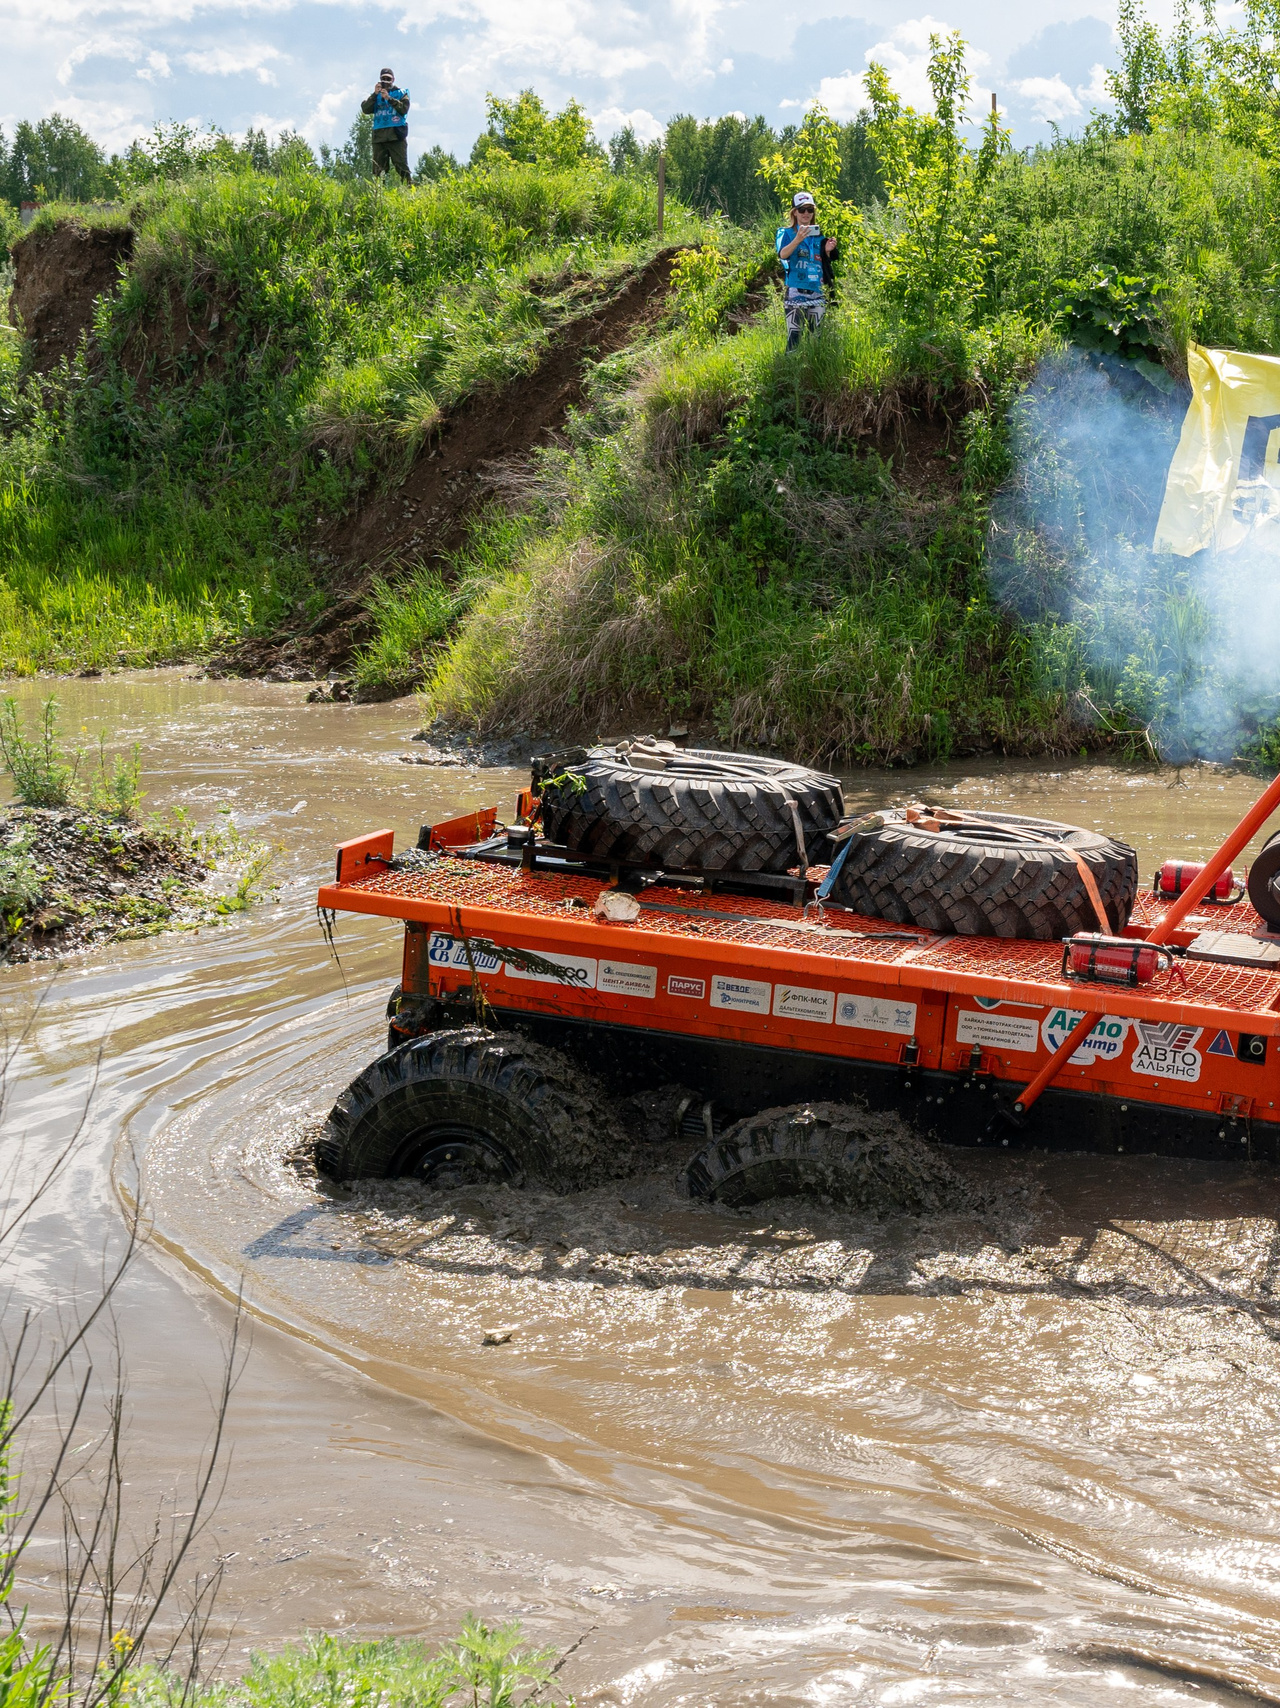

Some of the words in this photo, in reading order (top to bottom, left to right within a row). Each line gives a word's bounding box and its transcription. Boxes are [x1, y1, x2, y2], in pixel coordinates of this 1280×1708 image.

[602, 978, 624, 986] ЦЕНТР
[625, 980, 651, 989] ДИЗЕЛЬ
[671, 981, 702, 991] ПАРУС
[791, 994, 828, 1006] ФПК-МСК
[964, 1017, 1033, 1031] БАЙКАЛ-АВТОТРАК-СЕРВИС
[981, 1035, 1011, 1043] ИБРАГИМОВ
[1138, 1045, 1197, 1067] АВТО
[1136, 1059, 1196, 1077] АЛЬЯНС
